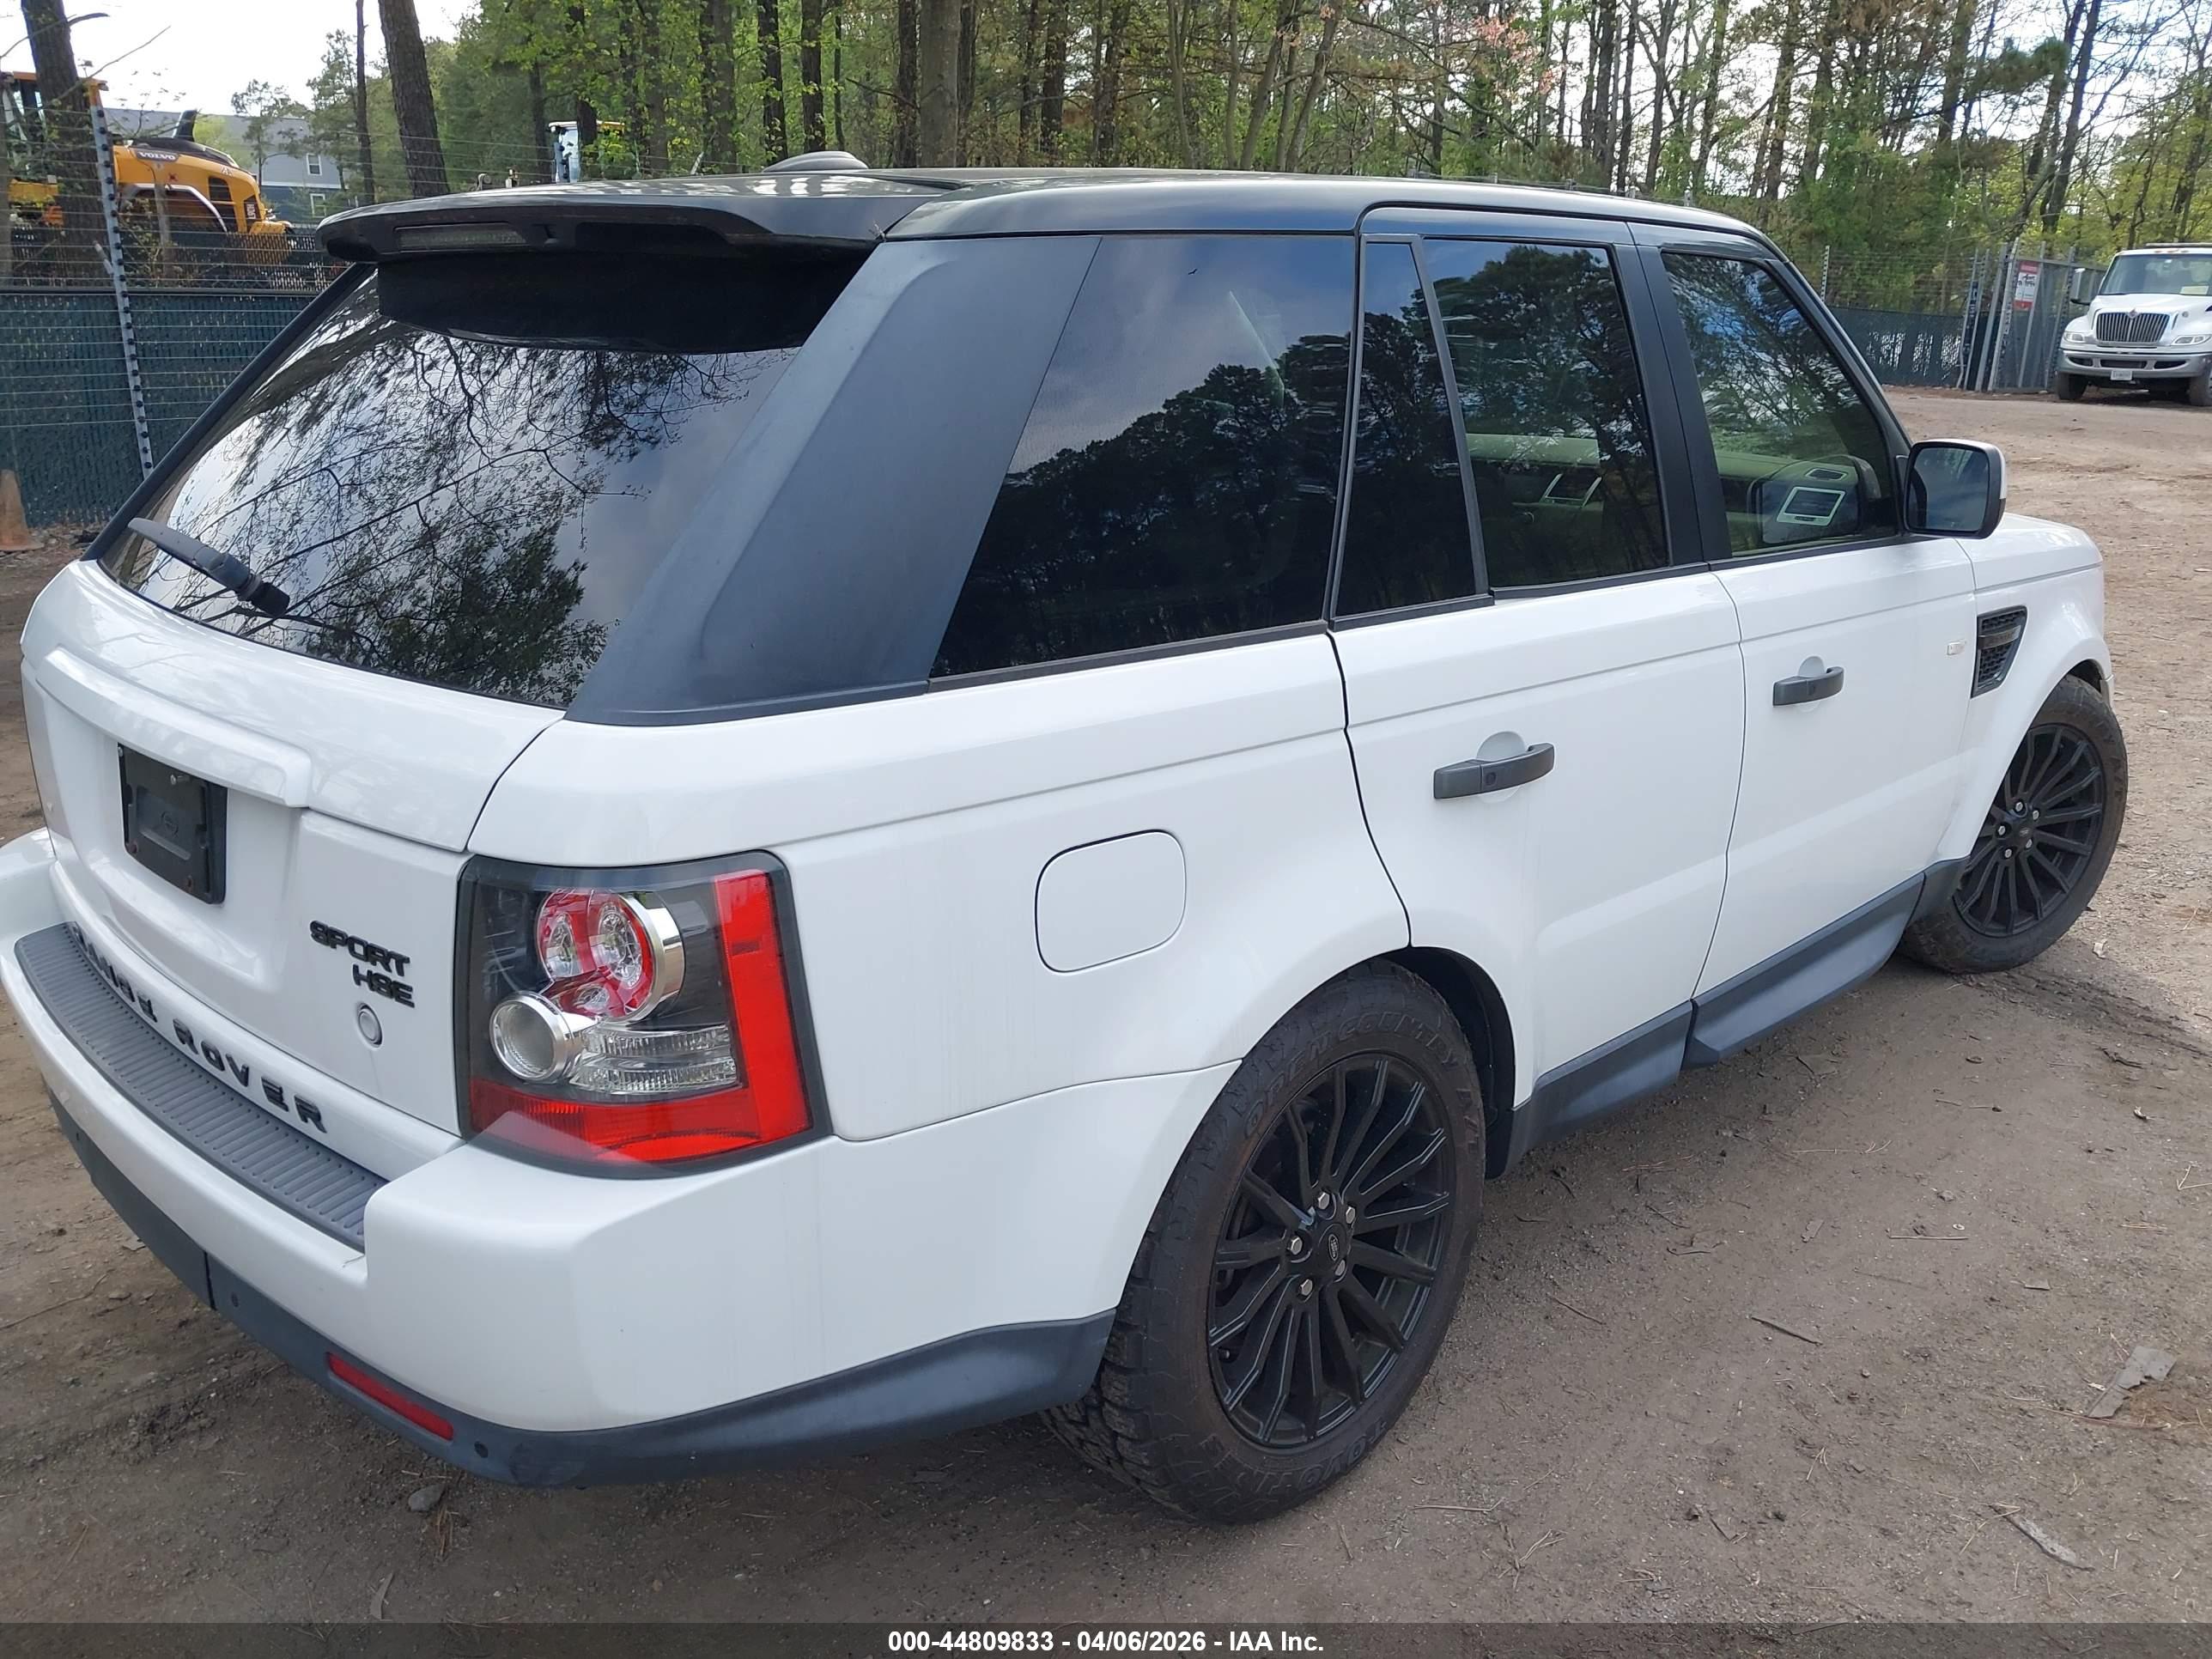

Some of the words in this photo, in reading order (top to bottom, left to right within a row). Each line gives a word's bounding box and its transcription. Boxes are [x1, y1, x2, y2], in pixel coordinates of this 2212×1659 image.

[138, 151, 176, 161] VOLVO
[309, 920, 410, 977] SPORT
[352, 963, 416, 1008] HSE
[1338, 1012, 1459, 1073] COUNTRY
[173, 1018, 327, 1133] ROVER
[1297, 1419, 1389, 1492] TOYO
